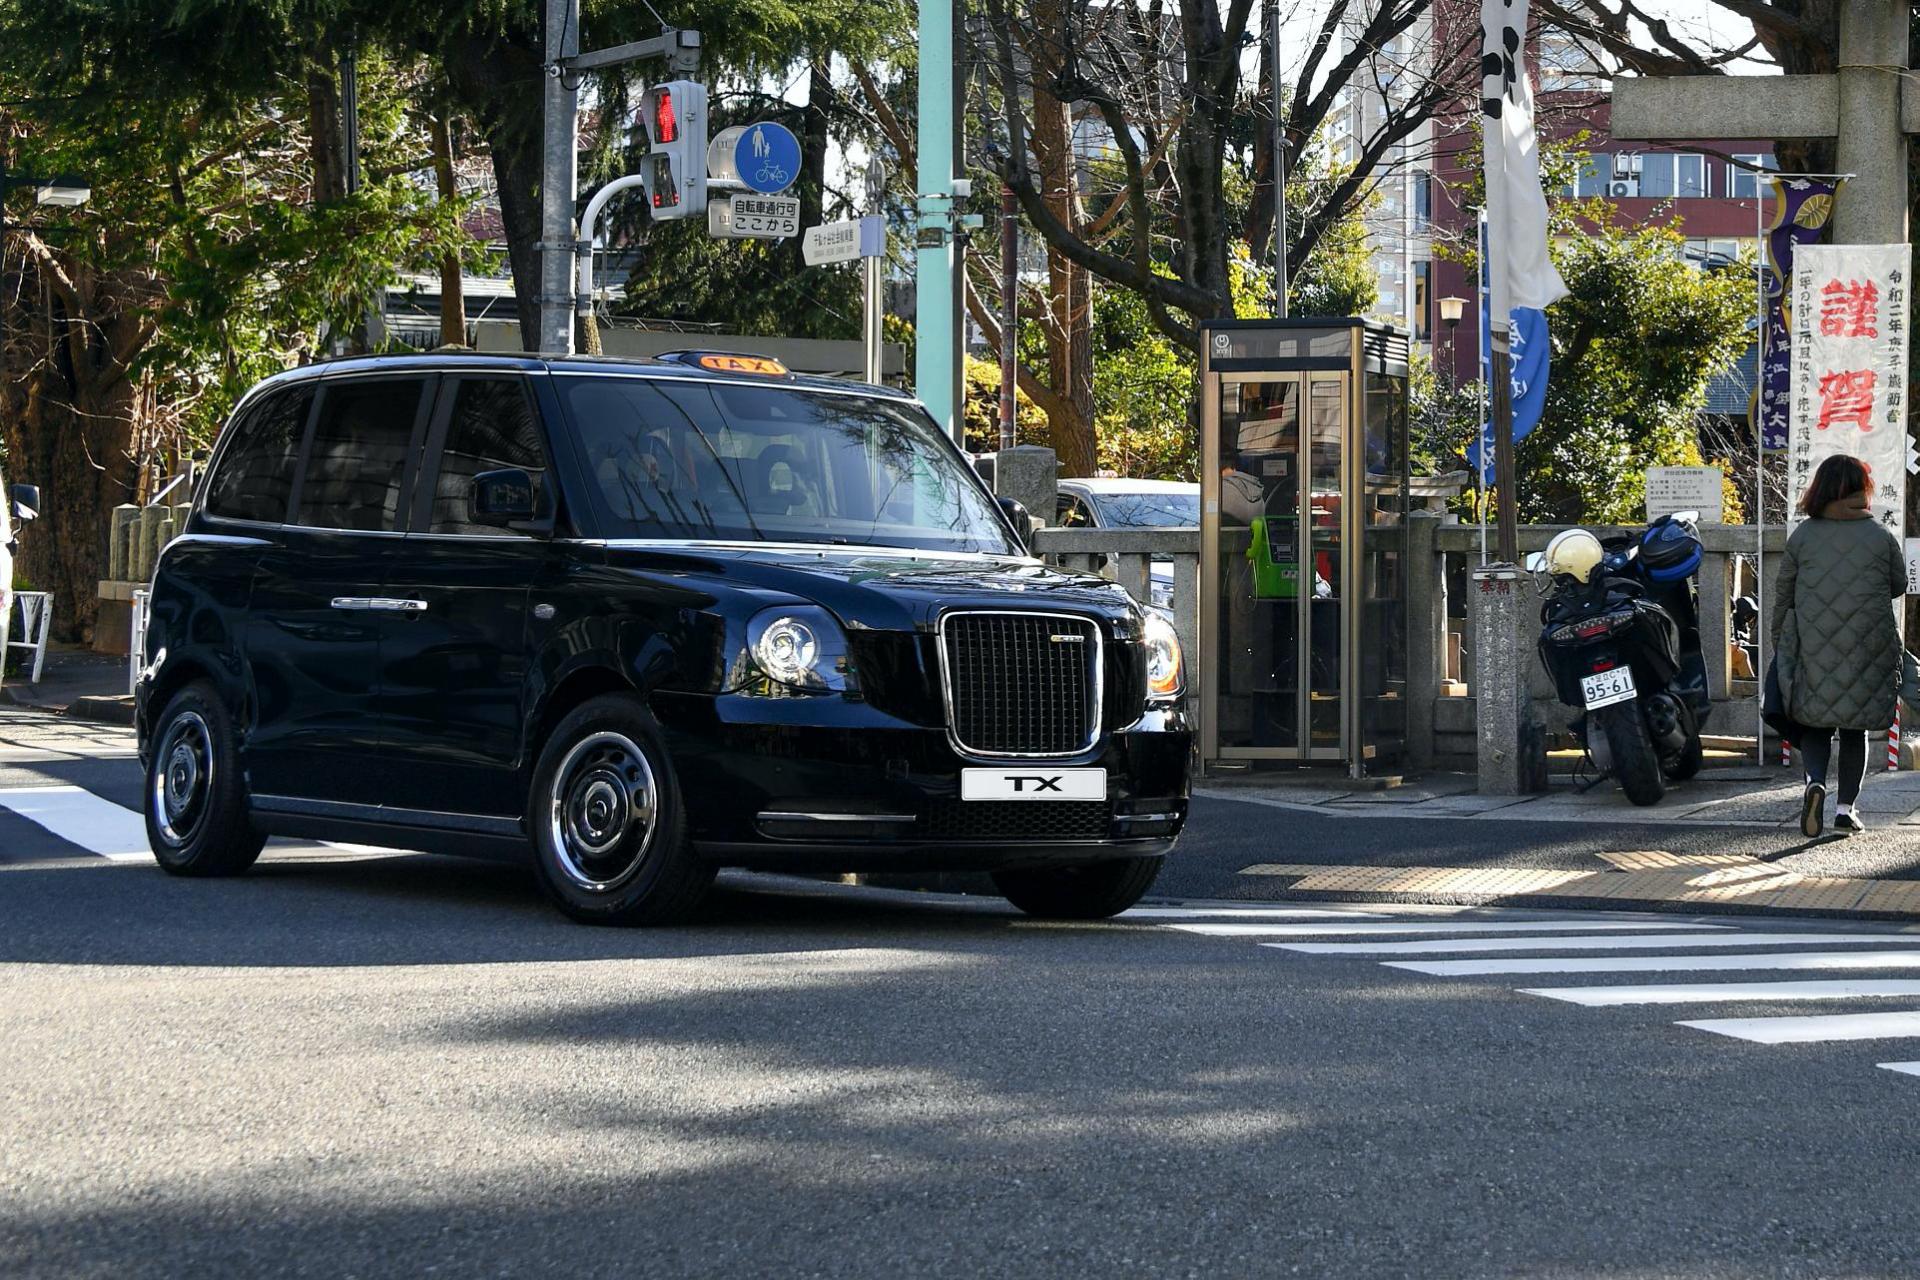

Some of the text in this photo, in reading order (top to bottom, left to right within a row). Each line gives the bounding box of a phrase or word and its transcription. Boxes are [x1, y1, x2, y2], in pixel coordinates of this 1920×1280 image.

[735, 200, 796, 216] 自転車通行可
[735, 217, 795, 233] ここから
[707, 357, 780, 372] TAXI
[1817, 279, 1877, 487] 謹賀
[1909, 559, 1917, 592] ください
[1586, 676, 1629, 701] 95-61
[1004, 776, 1063, 792] TX
